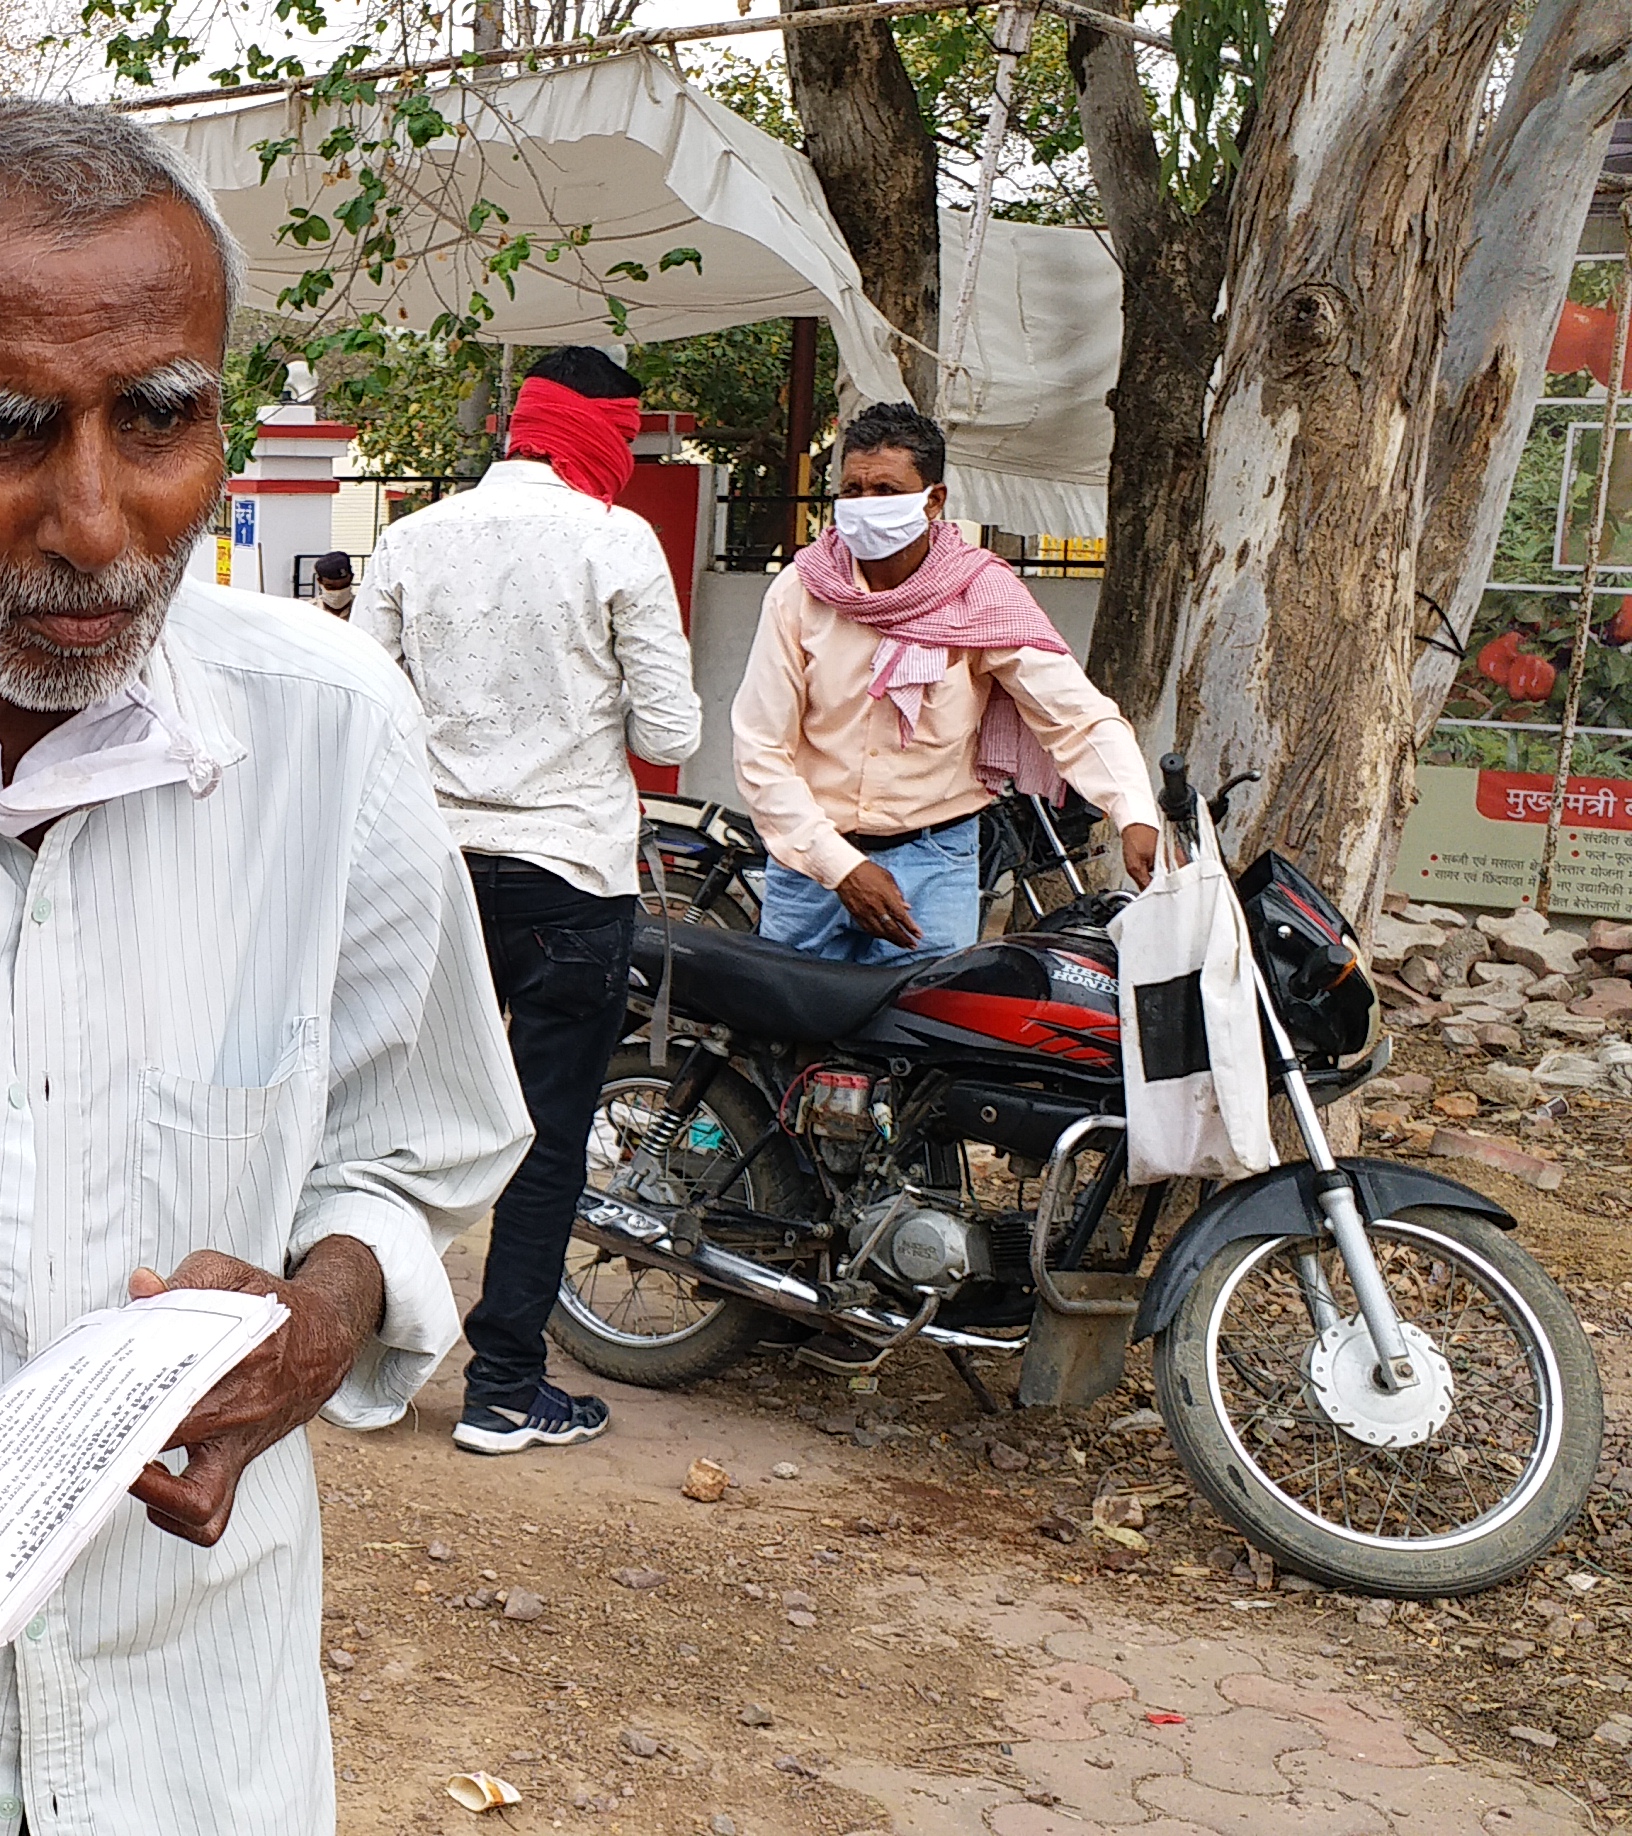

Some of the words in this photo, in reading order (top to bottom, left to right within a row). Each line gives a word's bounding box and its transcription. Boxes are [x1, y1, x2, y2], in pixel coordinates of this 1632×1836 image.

[1434, 869, 1459, 880] सागर
[1491, 858, 1524, 870] मसाला
[1590, 865, 1624, 880] योजना
[1051, 969, 1119, 996] HOND
